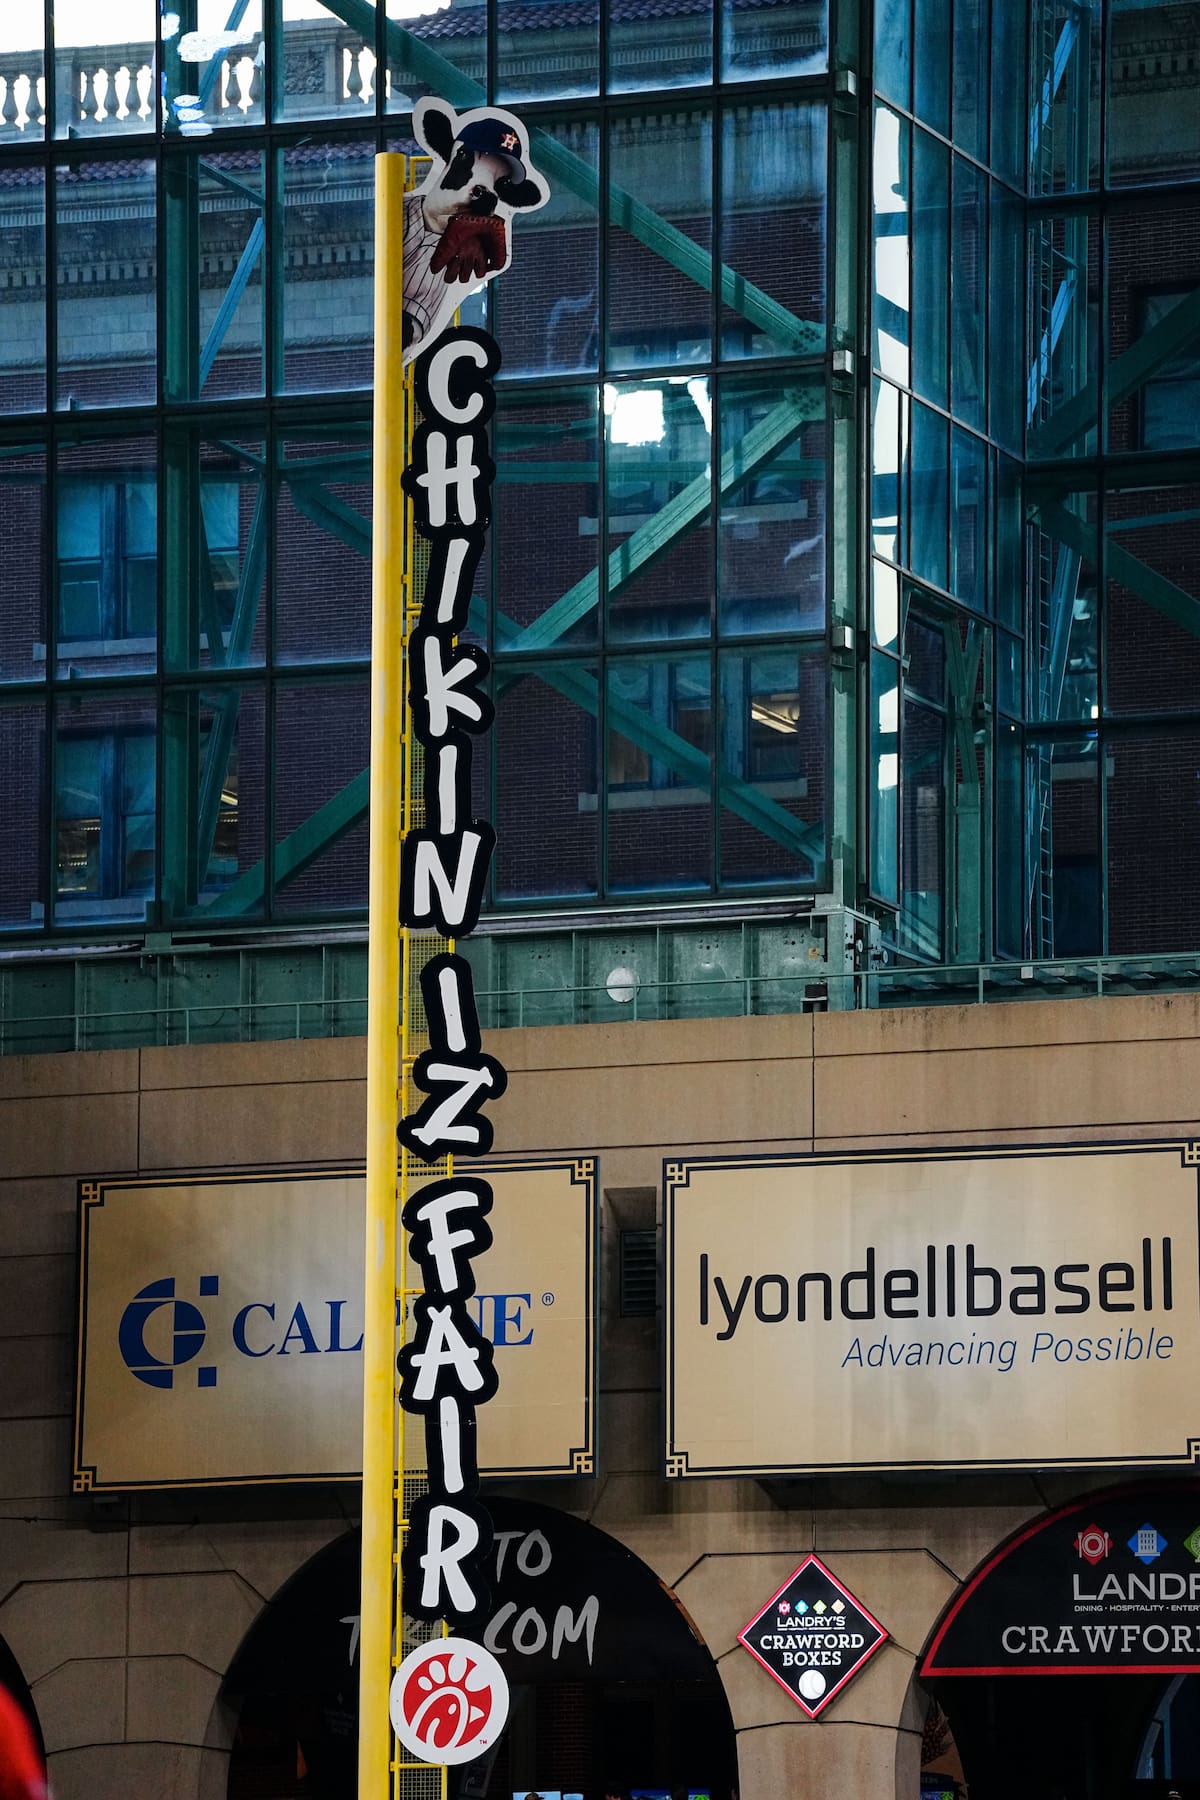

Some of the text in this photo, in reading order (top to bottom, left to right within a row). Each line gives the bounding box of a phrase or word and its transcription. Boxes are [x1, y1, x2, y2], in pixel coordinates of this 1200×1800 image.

[411, 340, 493, 1613] CHIKIN IZ FAIR
[700, 1237, 1173, 1340] lyondellbasell
[232, 1293, 534, 1358] CALE
[841, 1328, 1174, 1372] Advancing Possible
[493, 1529, 552, 1583] TO
[777, 1616, 846, 1628] LANDRY'S
[1109, 1604, 1164, 1612] HOSPITALITY
[760, 1634, 864, 1650] CRAWFORD
[1002, 1624, 1200, 1653] CRAWFOR
[783, 1651, 842, 1667] BOXES
